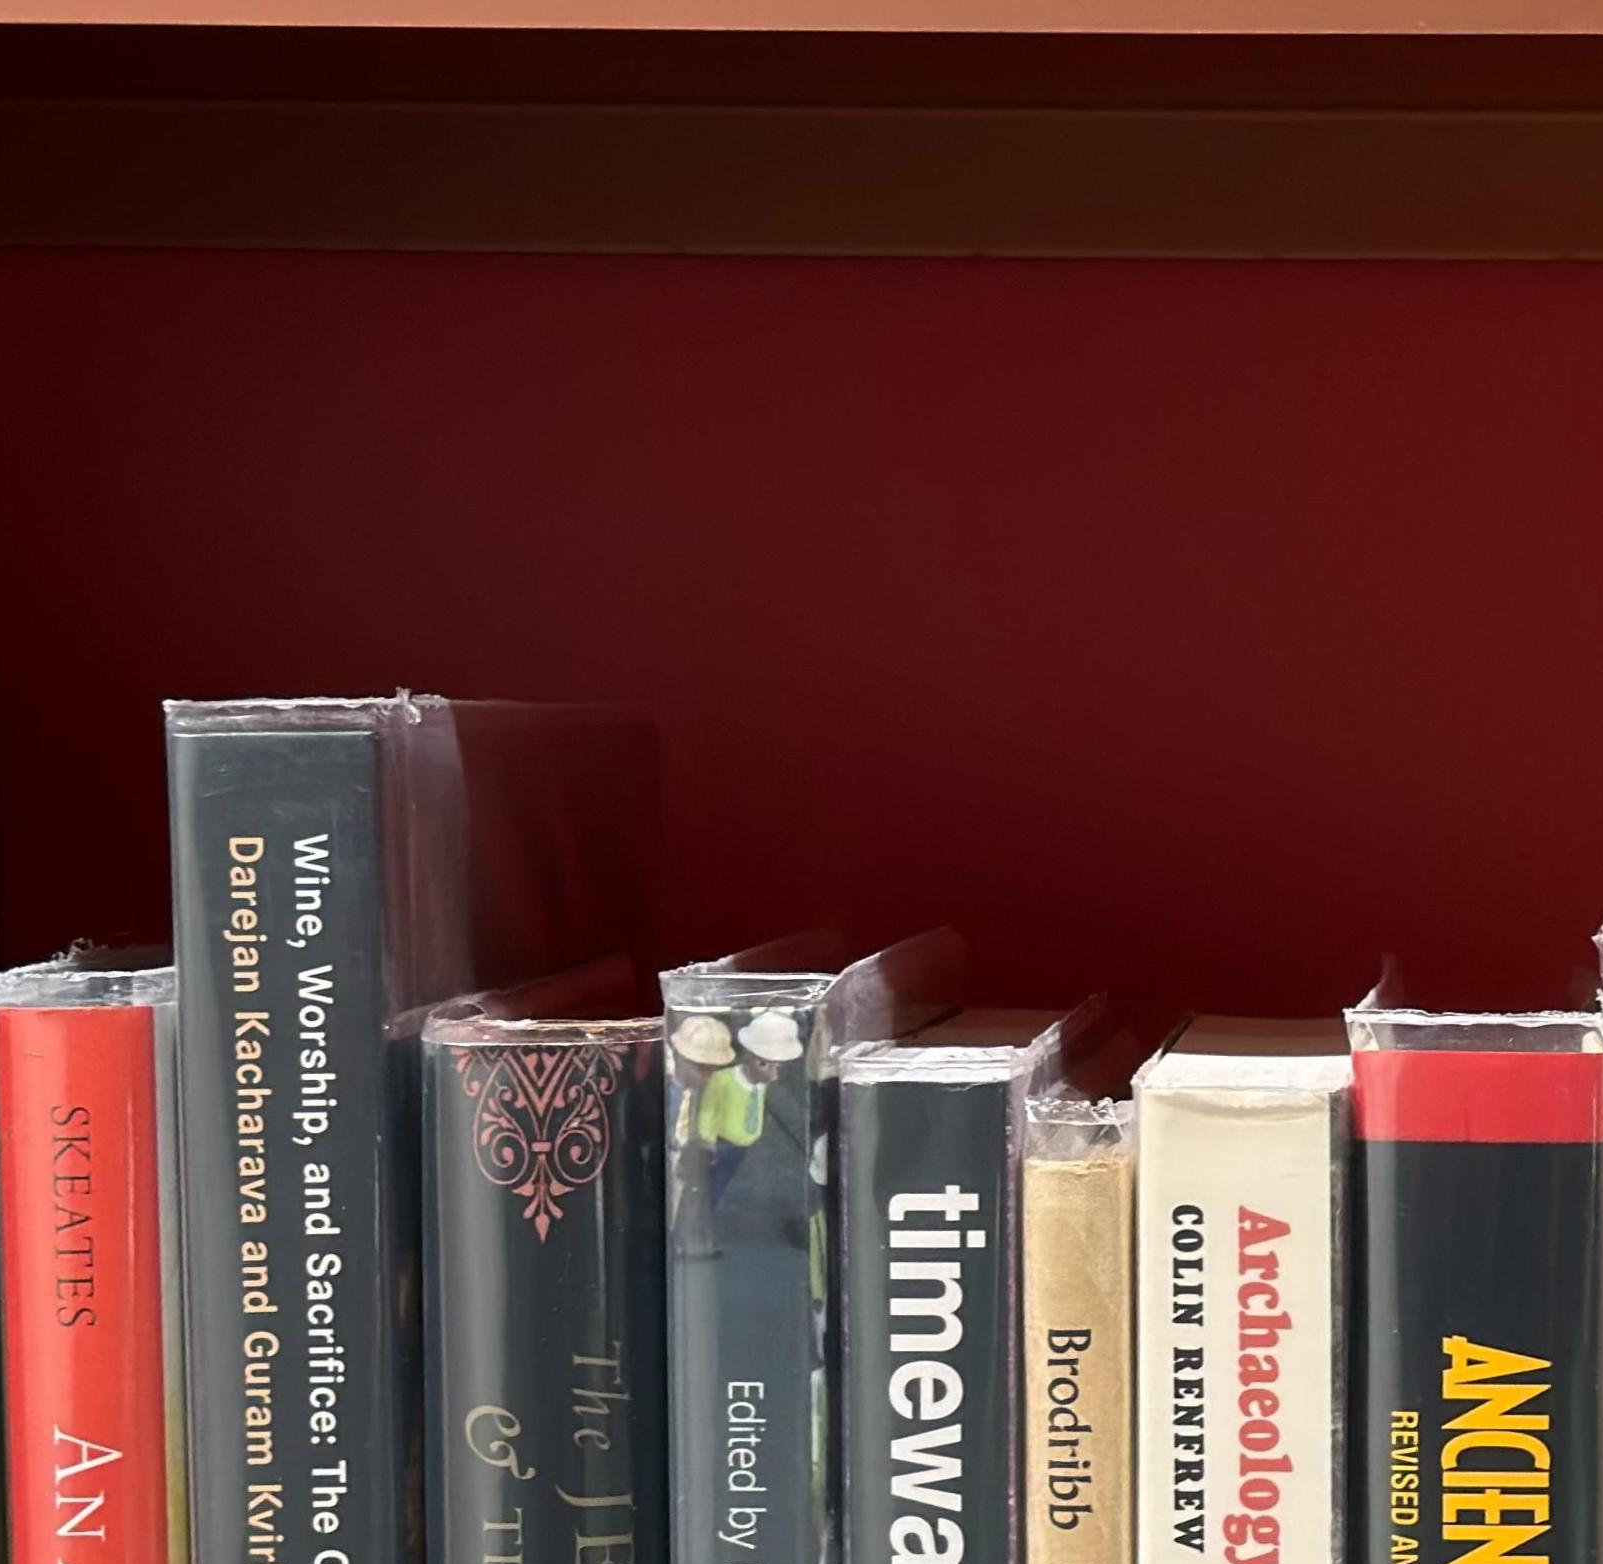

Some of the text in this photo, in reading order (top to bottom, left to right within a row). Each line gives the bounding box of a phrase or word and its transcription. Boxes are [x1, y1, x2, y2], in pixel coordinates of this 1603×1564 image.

[224, 836, 266, 993] Darejan
[285, 833, 333, 949] Wine,
[292, 965, 337, 1147] Worship,
[233, 1012, 272, 1224] Kacharava
[51, 1105, 95, 1328] SKEATES
[303, 1164, 340, 1236] and
[241, 1242, 278, 1314] and
[243, 1332, 280, 1465] Guram
[305, 1253, 346, 1445] Sacrifice:
[573, 1341, 631, 1451] The
[1171, 1204, 1206, 1554] COLIN RENFREW
[53, 1425, 123, 1539] AN
[465, 1405, 535, 1481] &
[728, 1381, 764, 1491] Edited
[1046, 1328, 1092, 1531] Brodribb
[1390, 1410, 1420, 1526] REVISED
[309, 1461, 348, 1533] The
[719, 1508, 767, 1550] by
